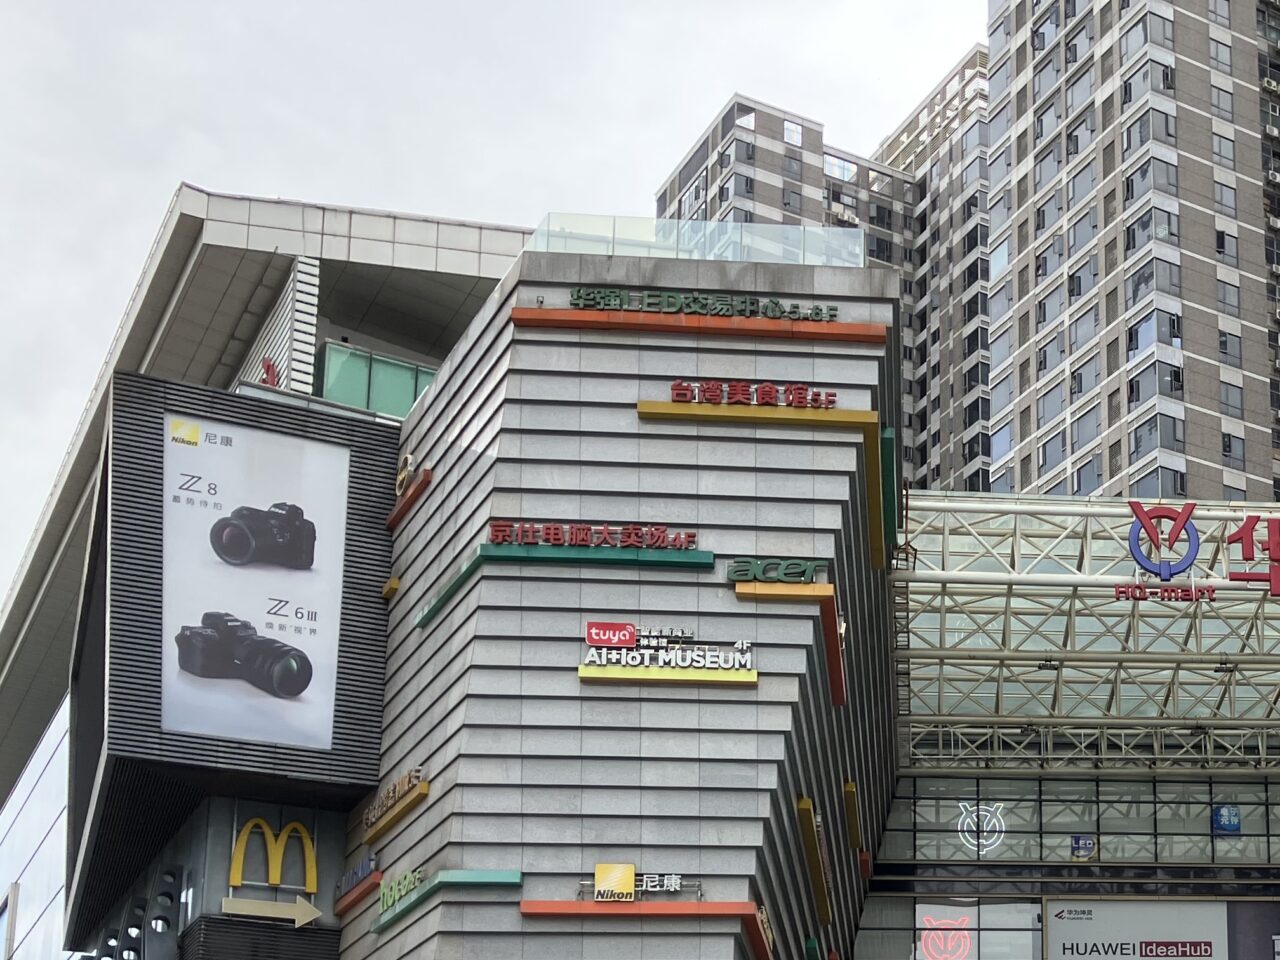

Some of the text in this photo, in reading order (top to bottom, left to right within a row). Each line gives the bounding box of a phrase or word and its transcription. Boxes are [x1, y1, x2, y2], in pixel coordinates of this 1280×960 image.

[670, 379, 837, 409] 台湾美食馆5F
[171, 432, 233, 447] Nikon 尼康
[207, 482, 218, 496] 8
[488, 520, 697, 550] 京仕电脑大卖场4F
[726, 557, 829, 583] acer
[1115, 583, 1217, 602] HQ-mart
[590, 626, 631, 643] tuya
[733, 640, 751, 650] 4F
[658, 650, 751, 670] MUSEUM
[642, 874, 682, 892] 尼康
[595, 888, 634, 900] Nikon
[1062, 942, 1212, 957] HUAWEI IdeaHub
